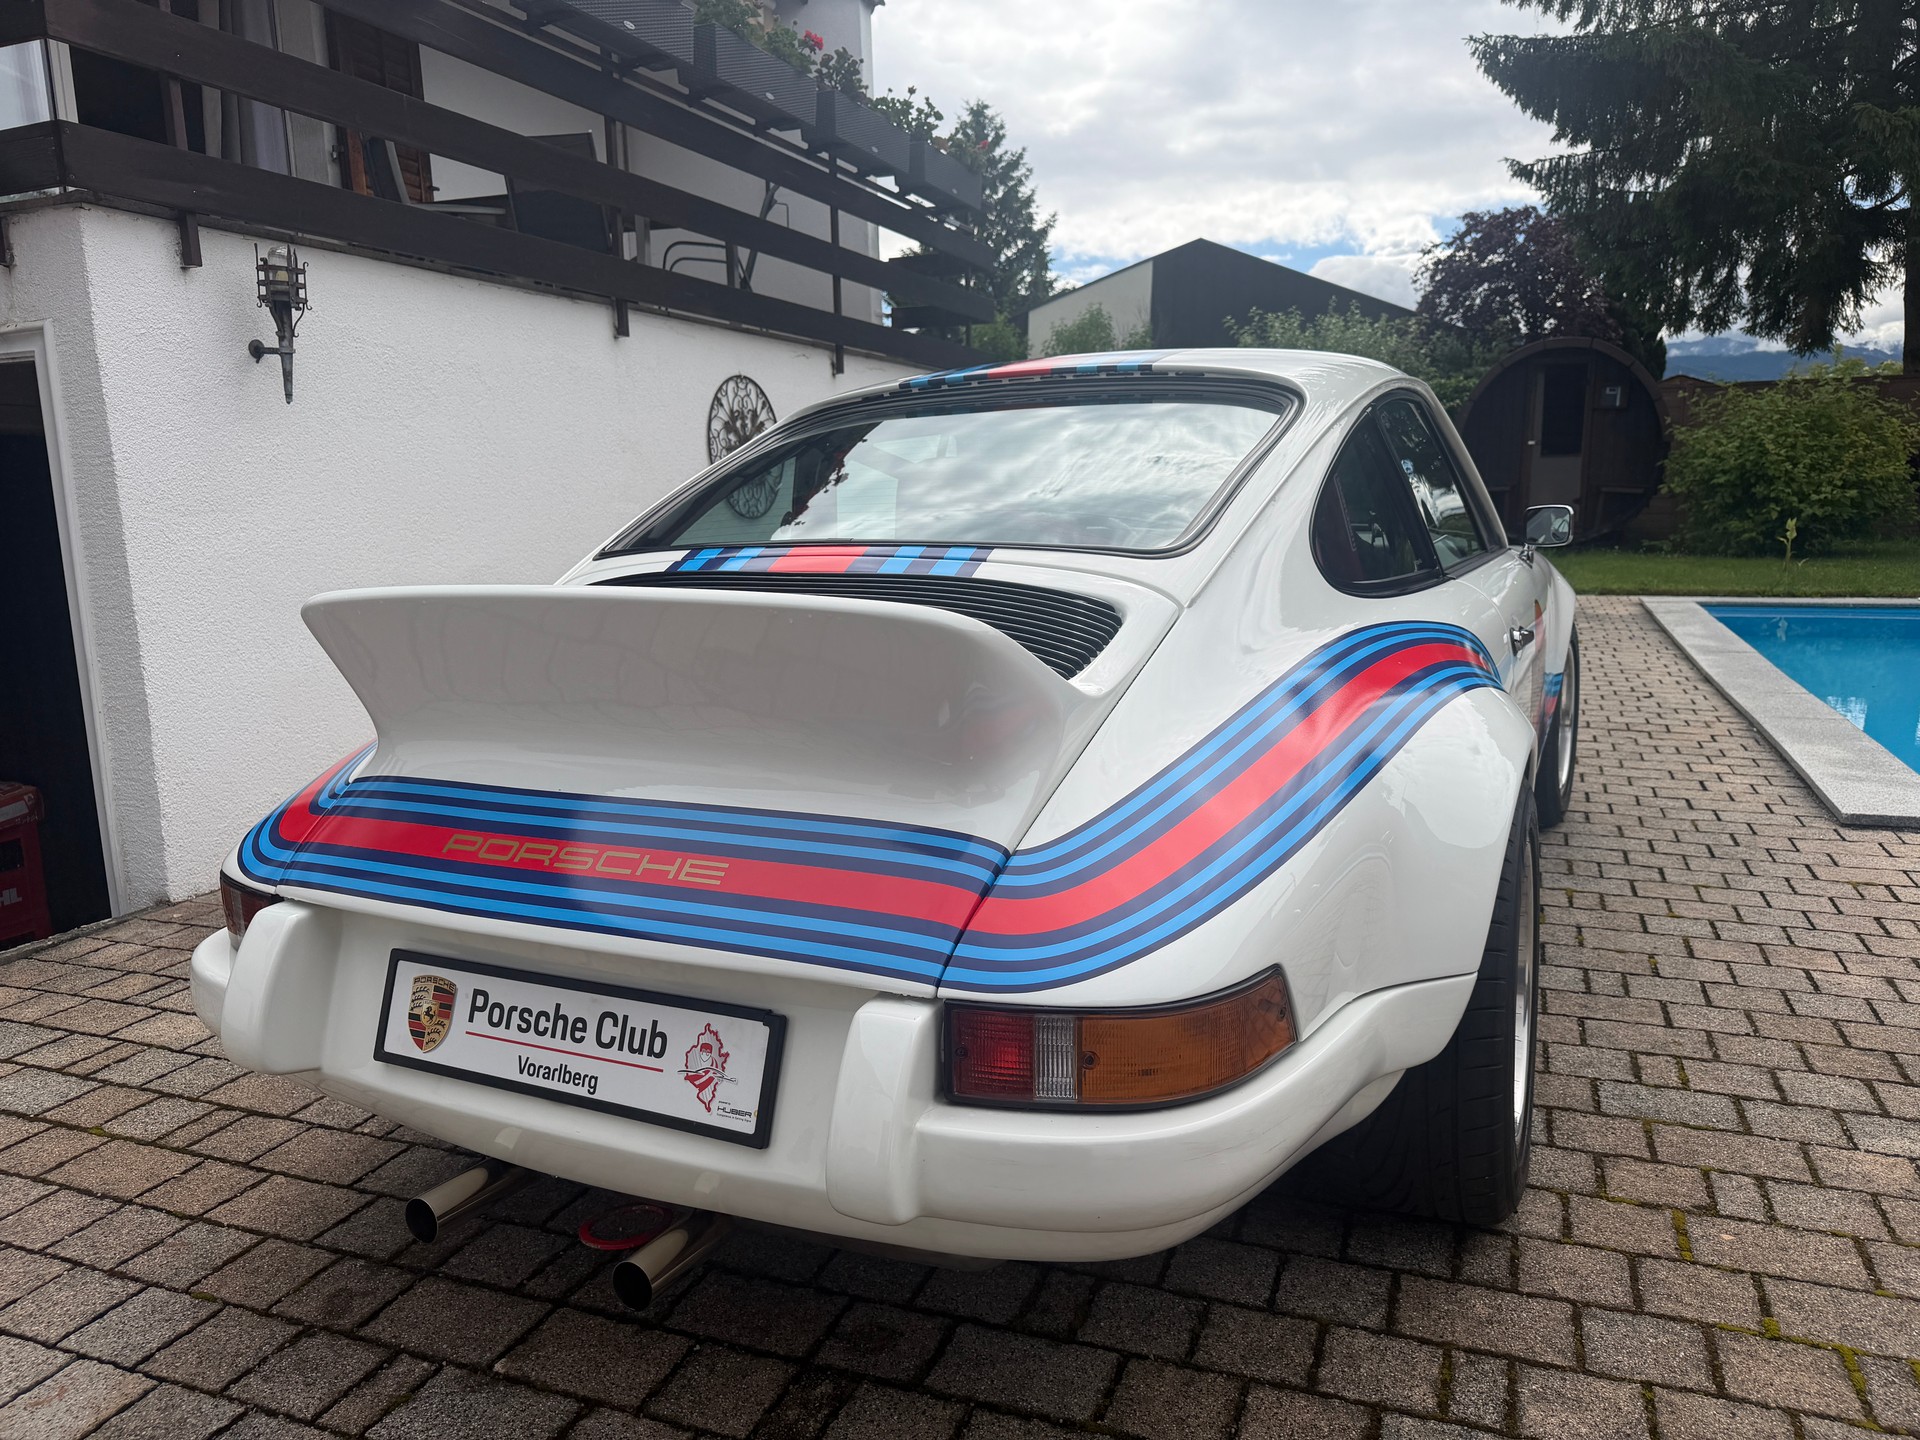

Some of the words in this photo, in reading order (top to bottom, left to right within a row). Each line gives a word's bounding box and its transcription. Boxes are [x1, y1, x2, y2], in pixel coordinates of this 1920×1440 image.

[442, 833, 729, 885] PORSCHE
[413, 976, 456, 992] PORSCHE
[467, 987, 588, 1044] Porsche
[595, 1010, 668, 1059] Club
[517, 1055, 598, 1095] Vorarlberg
[717, 1105, 753, 1118] HUBER
